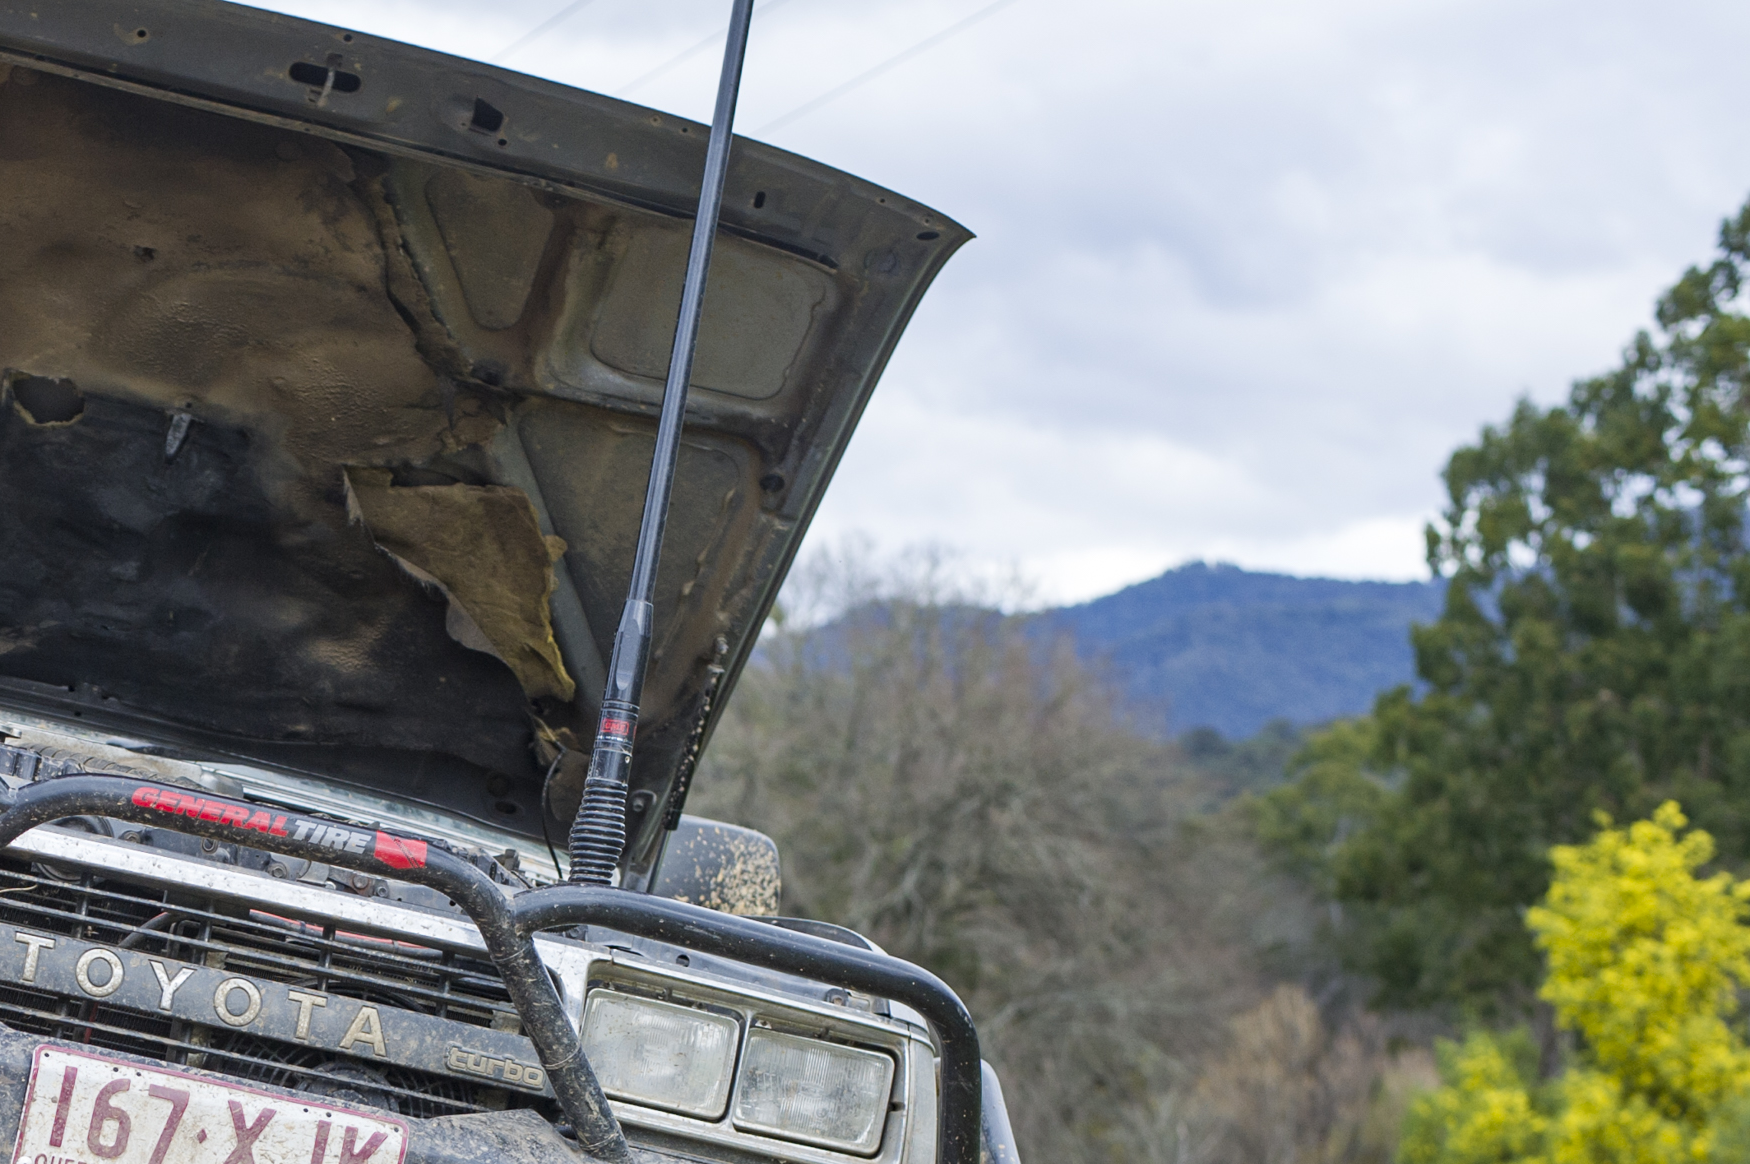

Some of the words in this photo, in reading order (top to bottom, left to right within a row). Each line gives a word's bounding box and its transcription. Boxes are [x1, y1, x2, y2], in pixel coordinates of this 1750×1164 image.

[131, 786, 290, 839] GENERAL
[293, 819, 372, 855] TIRE
[15, 931, 387, 1057] TOYOTA
[449, 1045, 546, 1087] turbo
